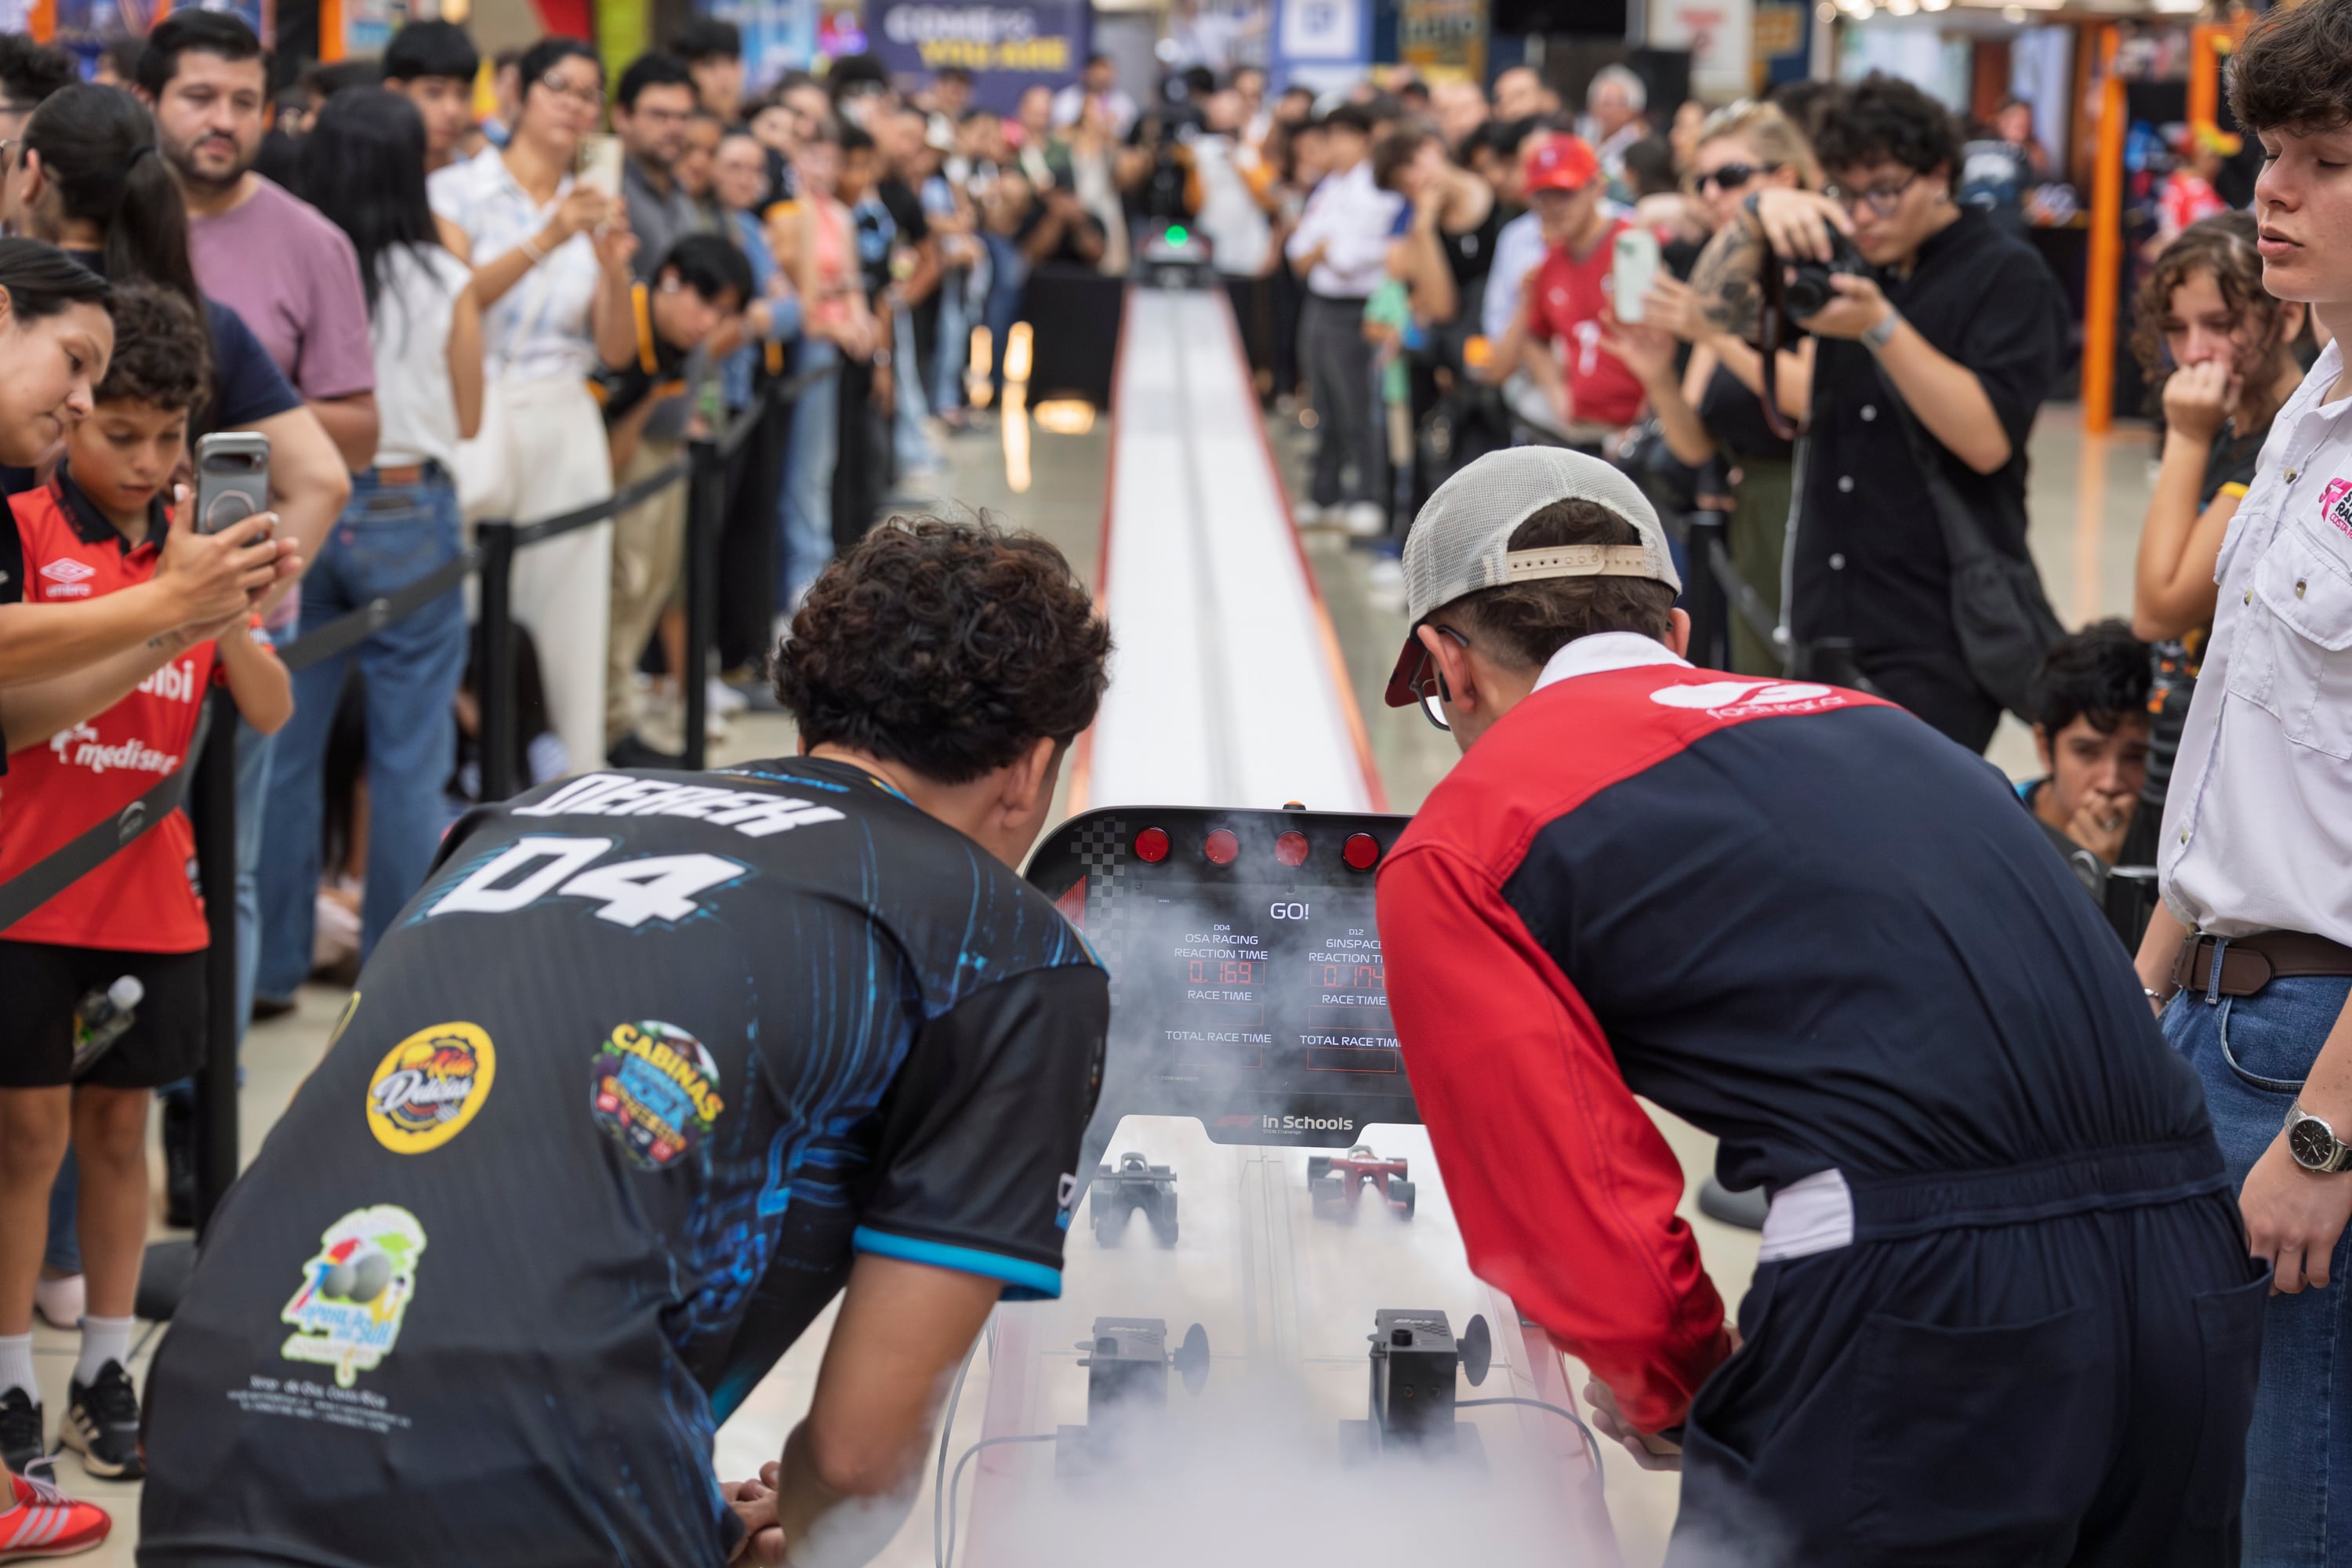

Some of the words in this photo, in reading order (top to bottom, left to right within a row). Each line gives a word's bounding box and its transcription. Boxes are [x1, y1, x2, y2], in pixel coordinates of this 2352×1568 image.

[1269, 902, 1310, 920] GO!
[1185, 933, 1210, 943] OSA
[1212, 935, 1259, 945] RACING
[1174, 948, 1236, 959] REACTION
[1238, 949, 1269, 960] TIME
[1308, 953, 1370, 964] REACTION
[1373, 954, 1383, 964] TI
[1189, 960, 1252, 985] 0.169
[1187, 989, 1220, 1000] RACE
[1221, 991, 1253, 1001] TIME
[1322, 994, 1355, 1004] RACE
[1356, 996, 1387, 1006] TIME
[1164, 1030, 1205, 1041] TOTAL
[1207, 1032, 1240, 1042] RACE
[1241, 1033, 1272, 1044] TIME
[1299, 1035, 1339, 1046] TOTAL
[1341, 1036, 1374, 1047] RACE
[612, 1023, 725, 1123] CABINAS
[1262, 1114, 1279, 1129] in
[1283, 1115, 1354, 1131] Schools
